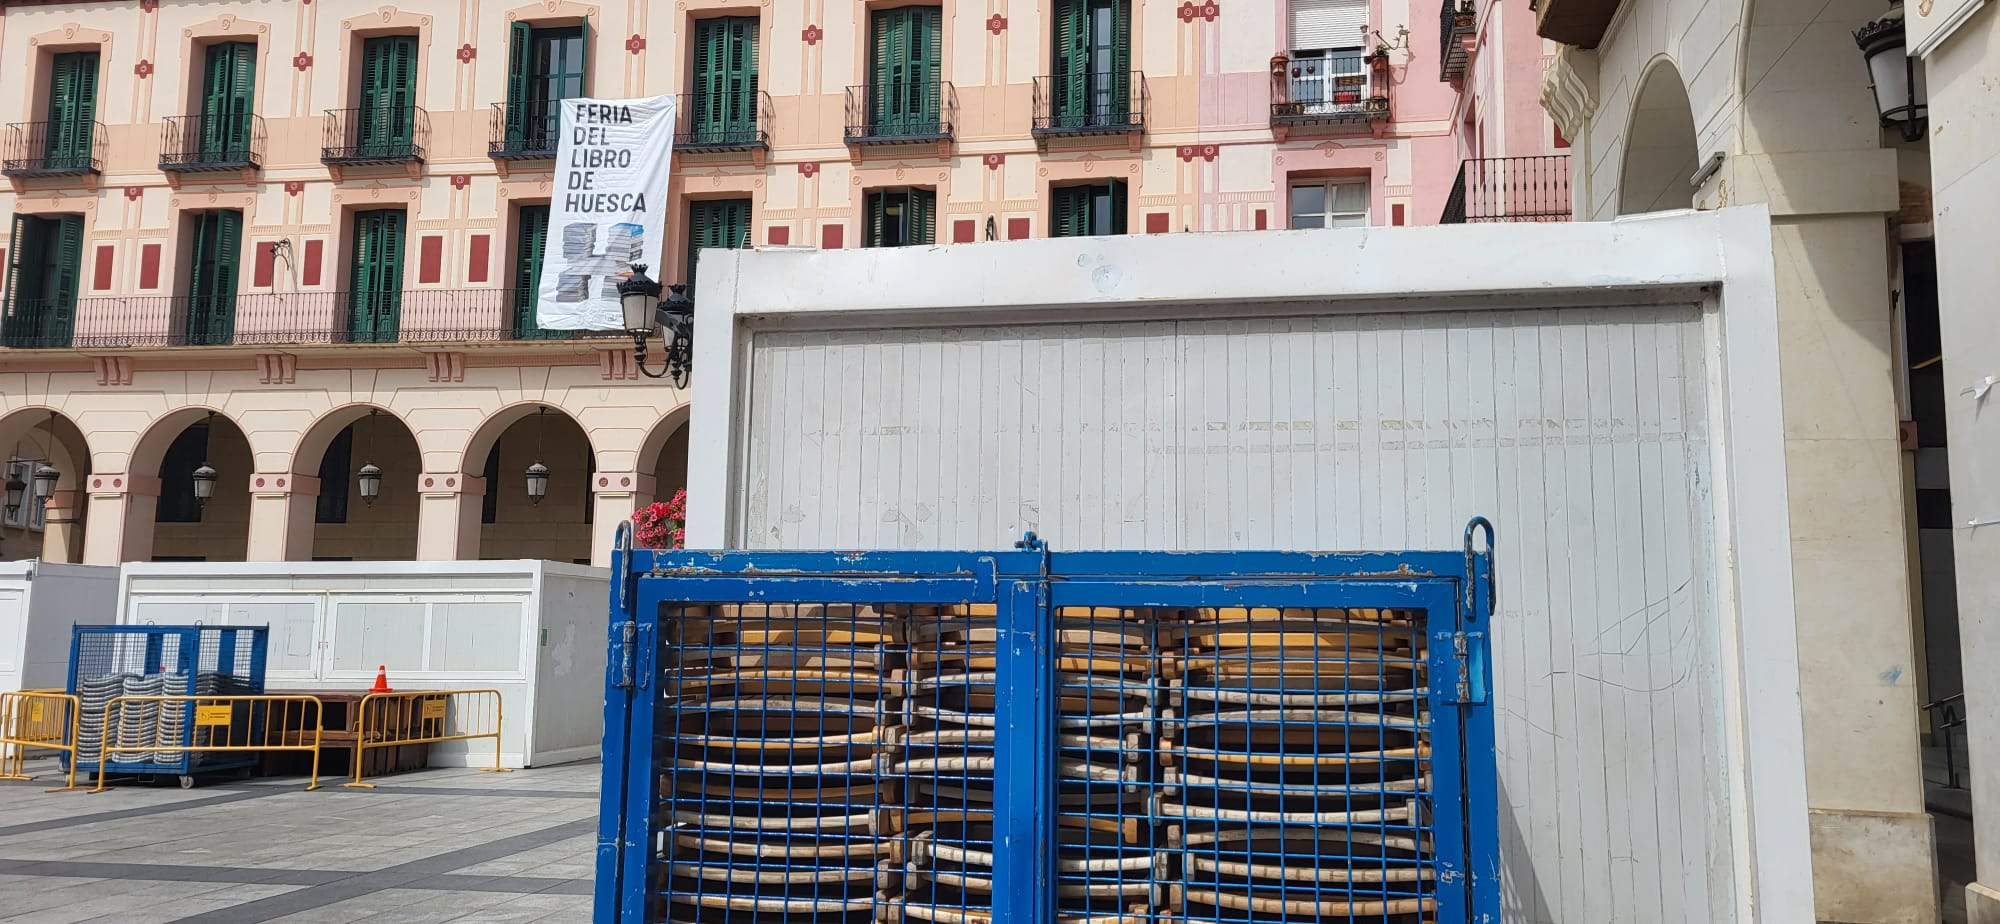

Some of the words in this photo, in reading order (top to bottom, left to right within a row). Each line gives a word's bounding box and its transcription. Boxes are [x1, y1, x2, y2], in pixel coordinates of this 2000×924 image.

[576, 104, 632, 124] FERIA
[573, 126, 610, 146] DEL
[571, 149, 631, 168] LIBRO
[568, 171, 594, 190] DE
[565, 193, 646, 213] HUESCA
